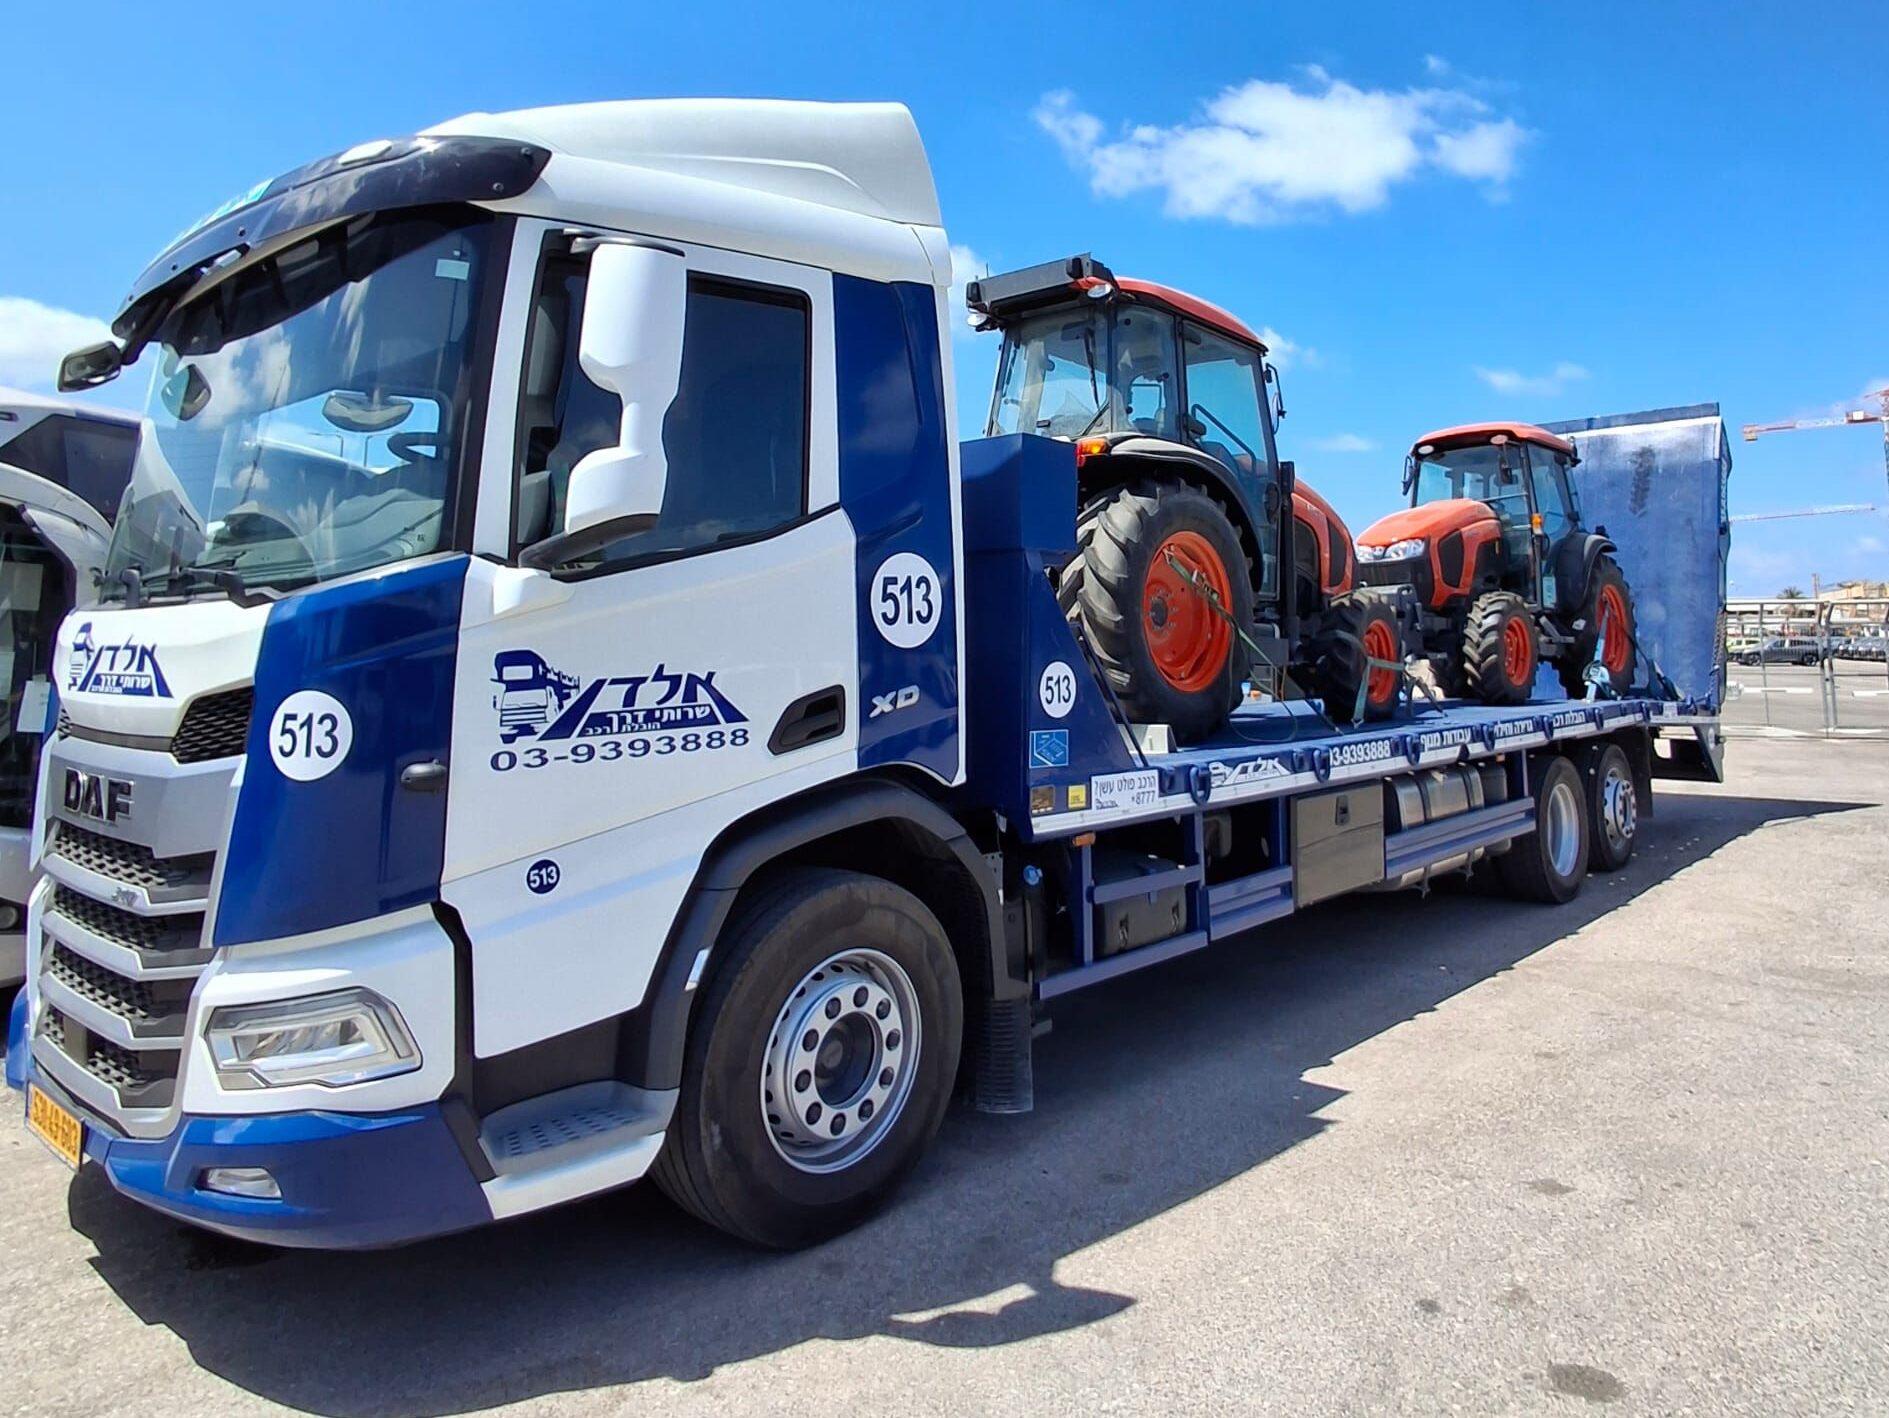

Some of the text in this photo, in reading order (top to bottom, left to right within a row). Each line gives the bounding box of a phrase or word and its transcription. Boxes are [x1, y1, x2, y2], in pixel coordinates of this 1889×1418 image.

[880, 575, 934, 626] 513
[869, 685, 920, 718] XD
[1045, 675, 1071, 705] 513
[584, 721, 661, 736] הובלת רכב
[606, 705, 711, 733] שרותי דרך
[279, 713, 339, 758] 513
[490, 728, 750, 772] 03-9393888
[64, 767, 135, 823] DAF
[1117, 776, 1135, 791] פולט
[529, 866, 558, 888] 513
